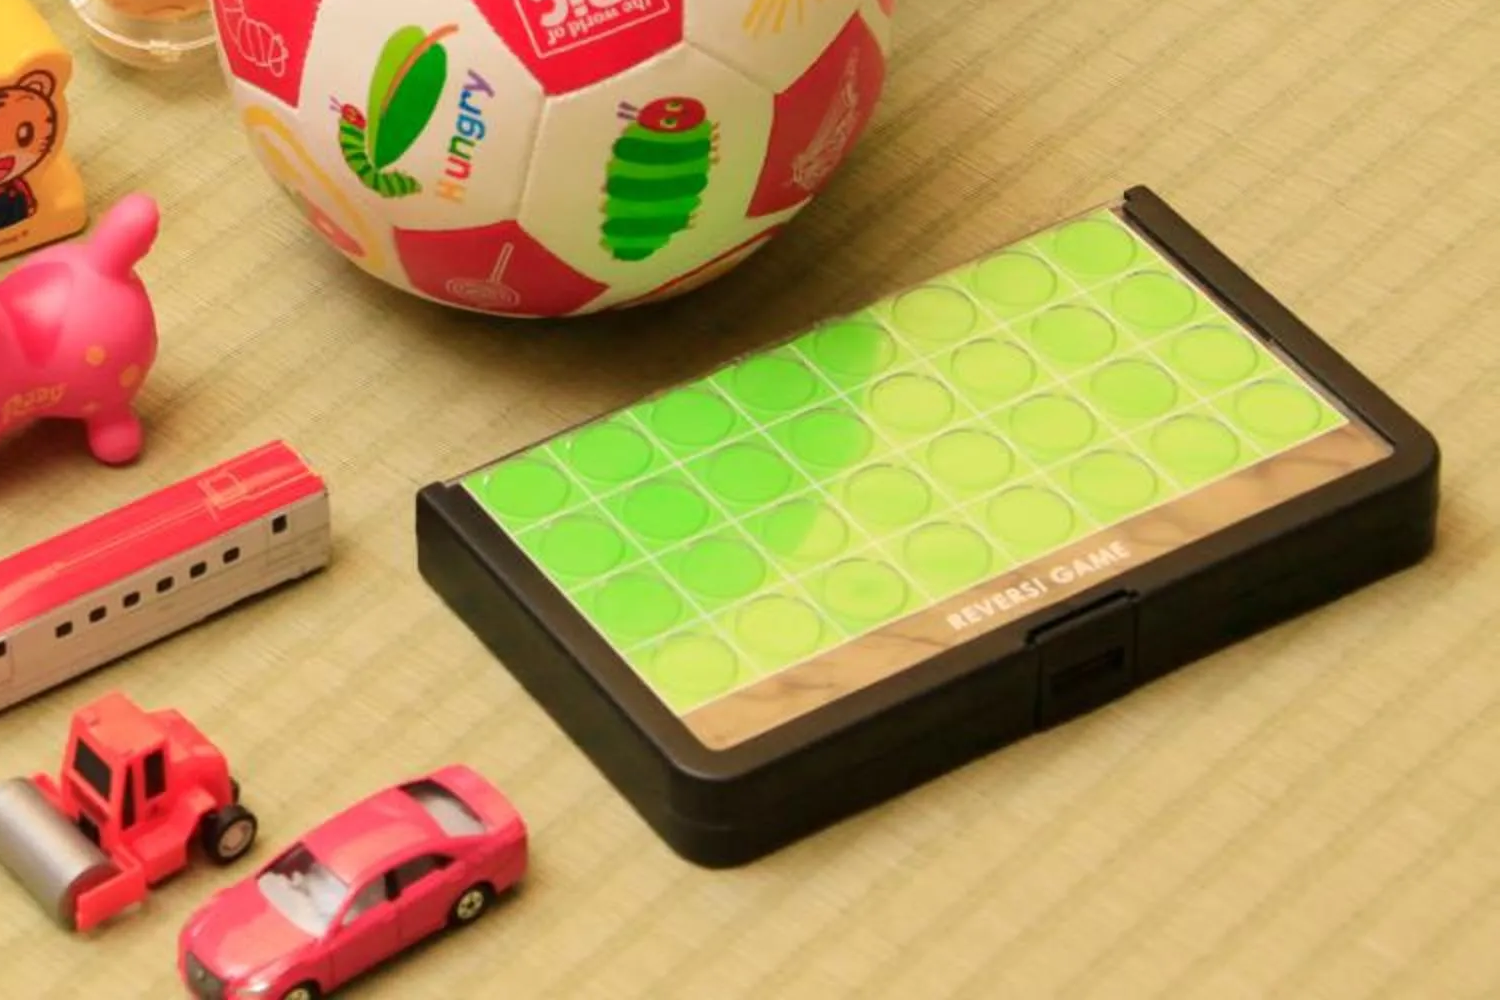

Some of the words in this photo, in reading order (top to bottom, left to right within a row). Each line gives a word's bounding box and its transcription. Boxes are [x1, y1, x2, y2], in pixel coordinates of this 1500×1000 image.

[568, 6, 620, 37] world
[434, 69, 496, 203] Hungry
[946, 577, 1049, 630] REVERSI
[1050, 540, 1131, 584] GAME
